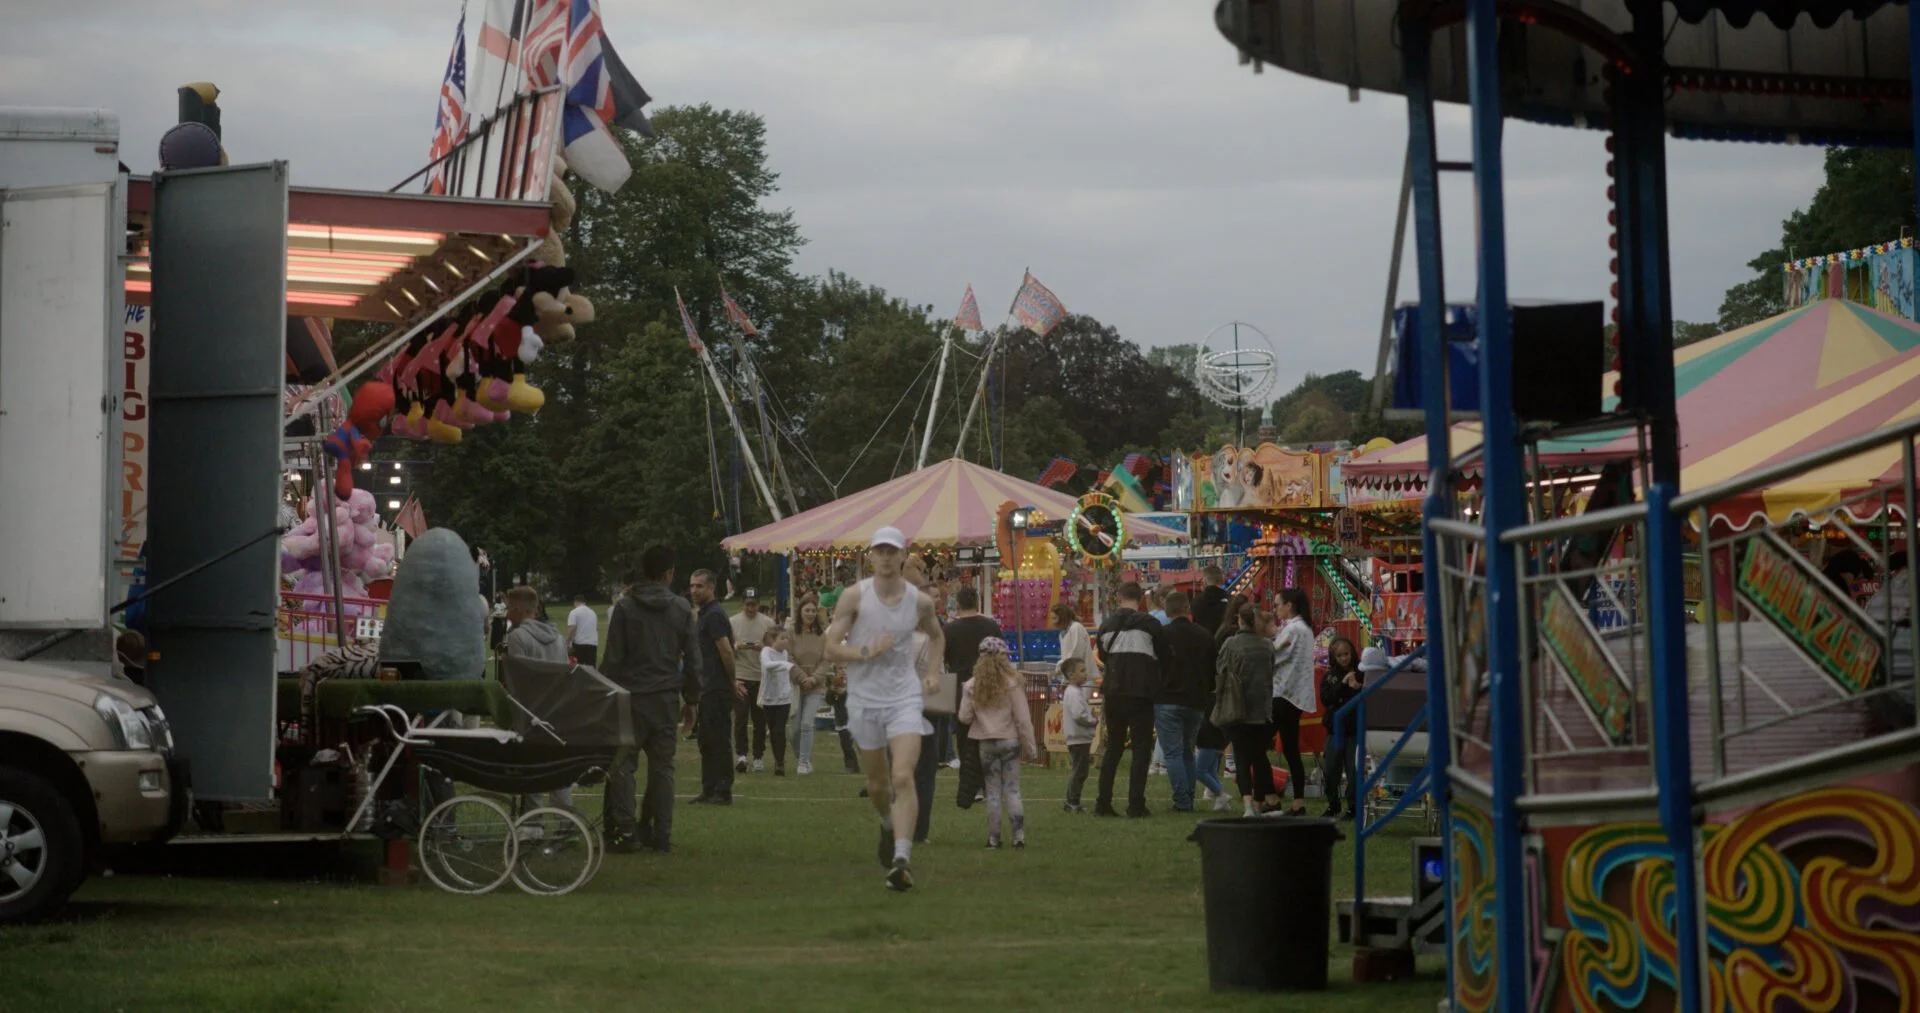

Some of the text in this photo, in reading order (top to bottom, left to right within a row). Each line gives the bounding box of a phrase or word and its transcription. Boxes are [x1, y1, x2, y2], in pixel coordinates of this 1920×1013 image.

[124, 303, 145, 325] HE
[123, 331, 146, 421] BIG
[1747, 541, 1881, 690] WALTZER
